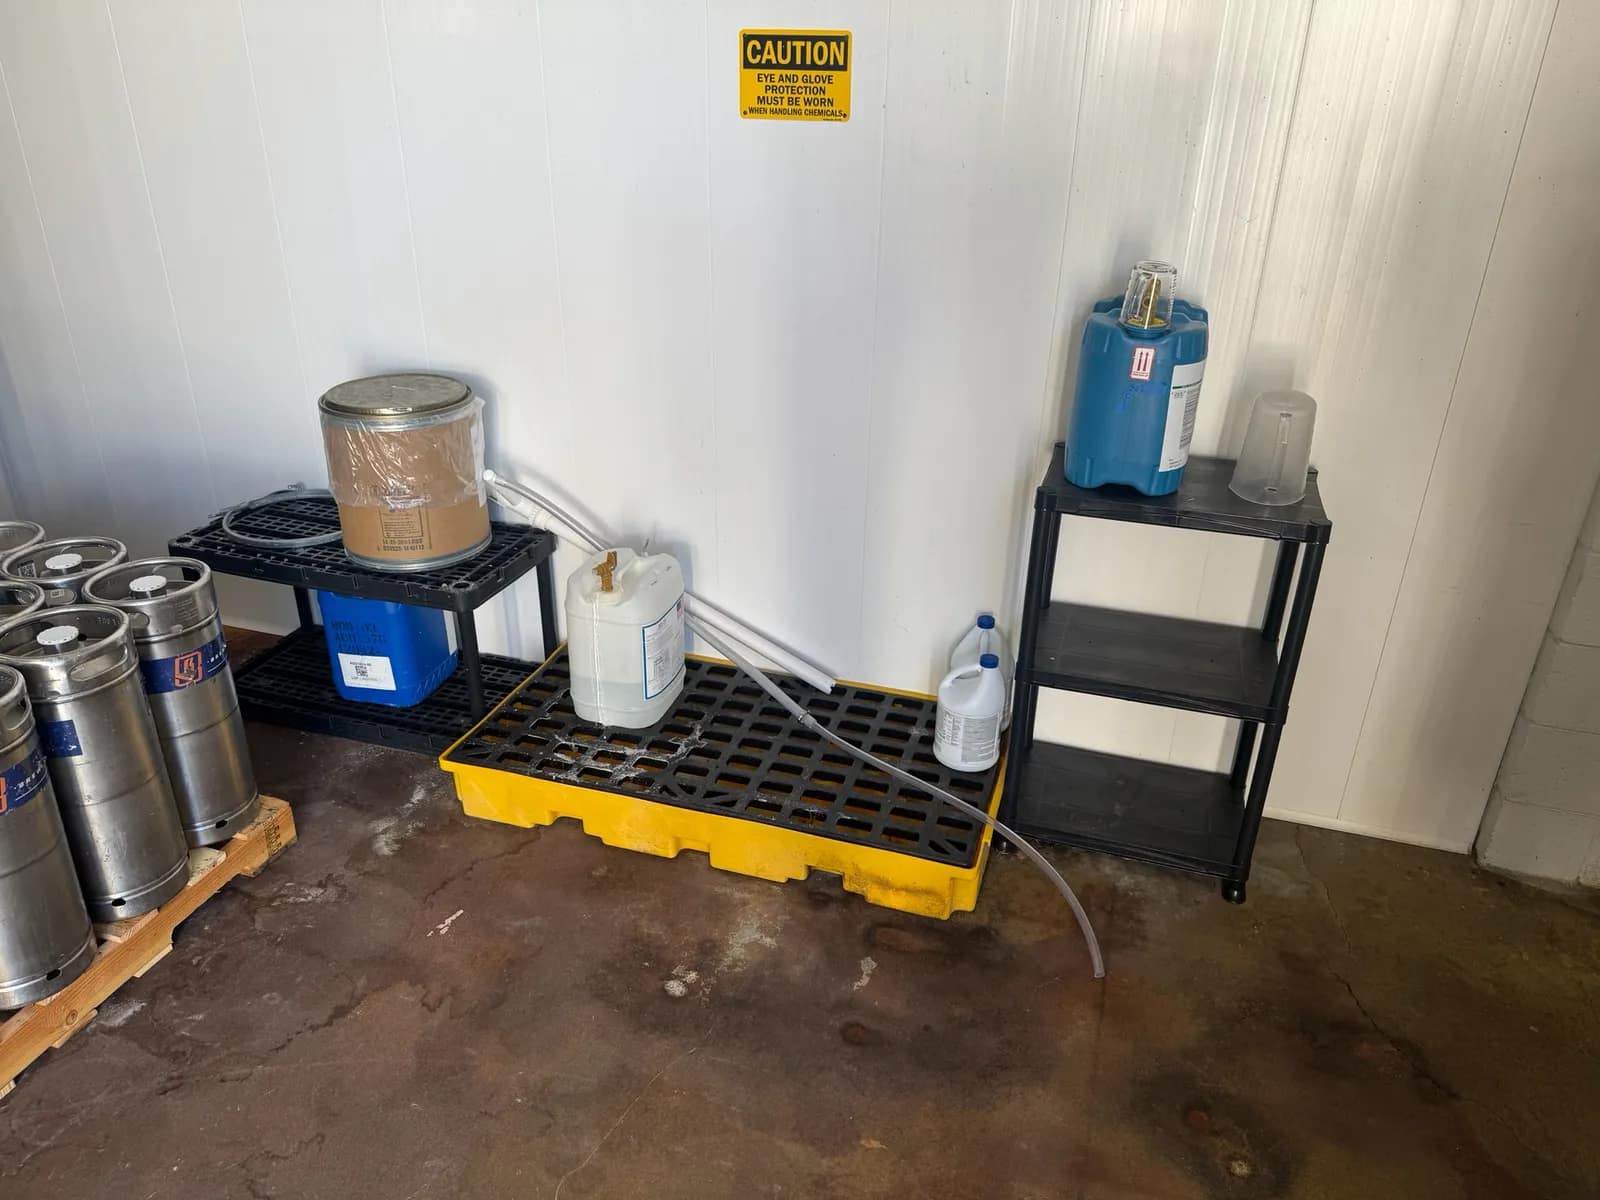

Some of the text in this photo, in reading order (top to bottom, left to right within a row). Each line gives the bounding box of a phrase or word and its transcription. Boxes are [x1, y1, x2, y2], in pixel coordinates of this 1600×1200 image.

[746, 39, 845, 66] CAUTION
[757, 73, 834, 84] EYE AND GLOVE
[764, 85, 826, 96] PROTECTION
[757, 96, 834, 107] MUST BE WORN
[748, 106, 843, 117] WHEN HANDLING CHEMICALS
